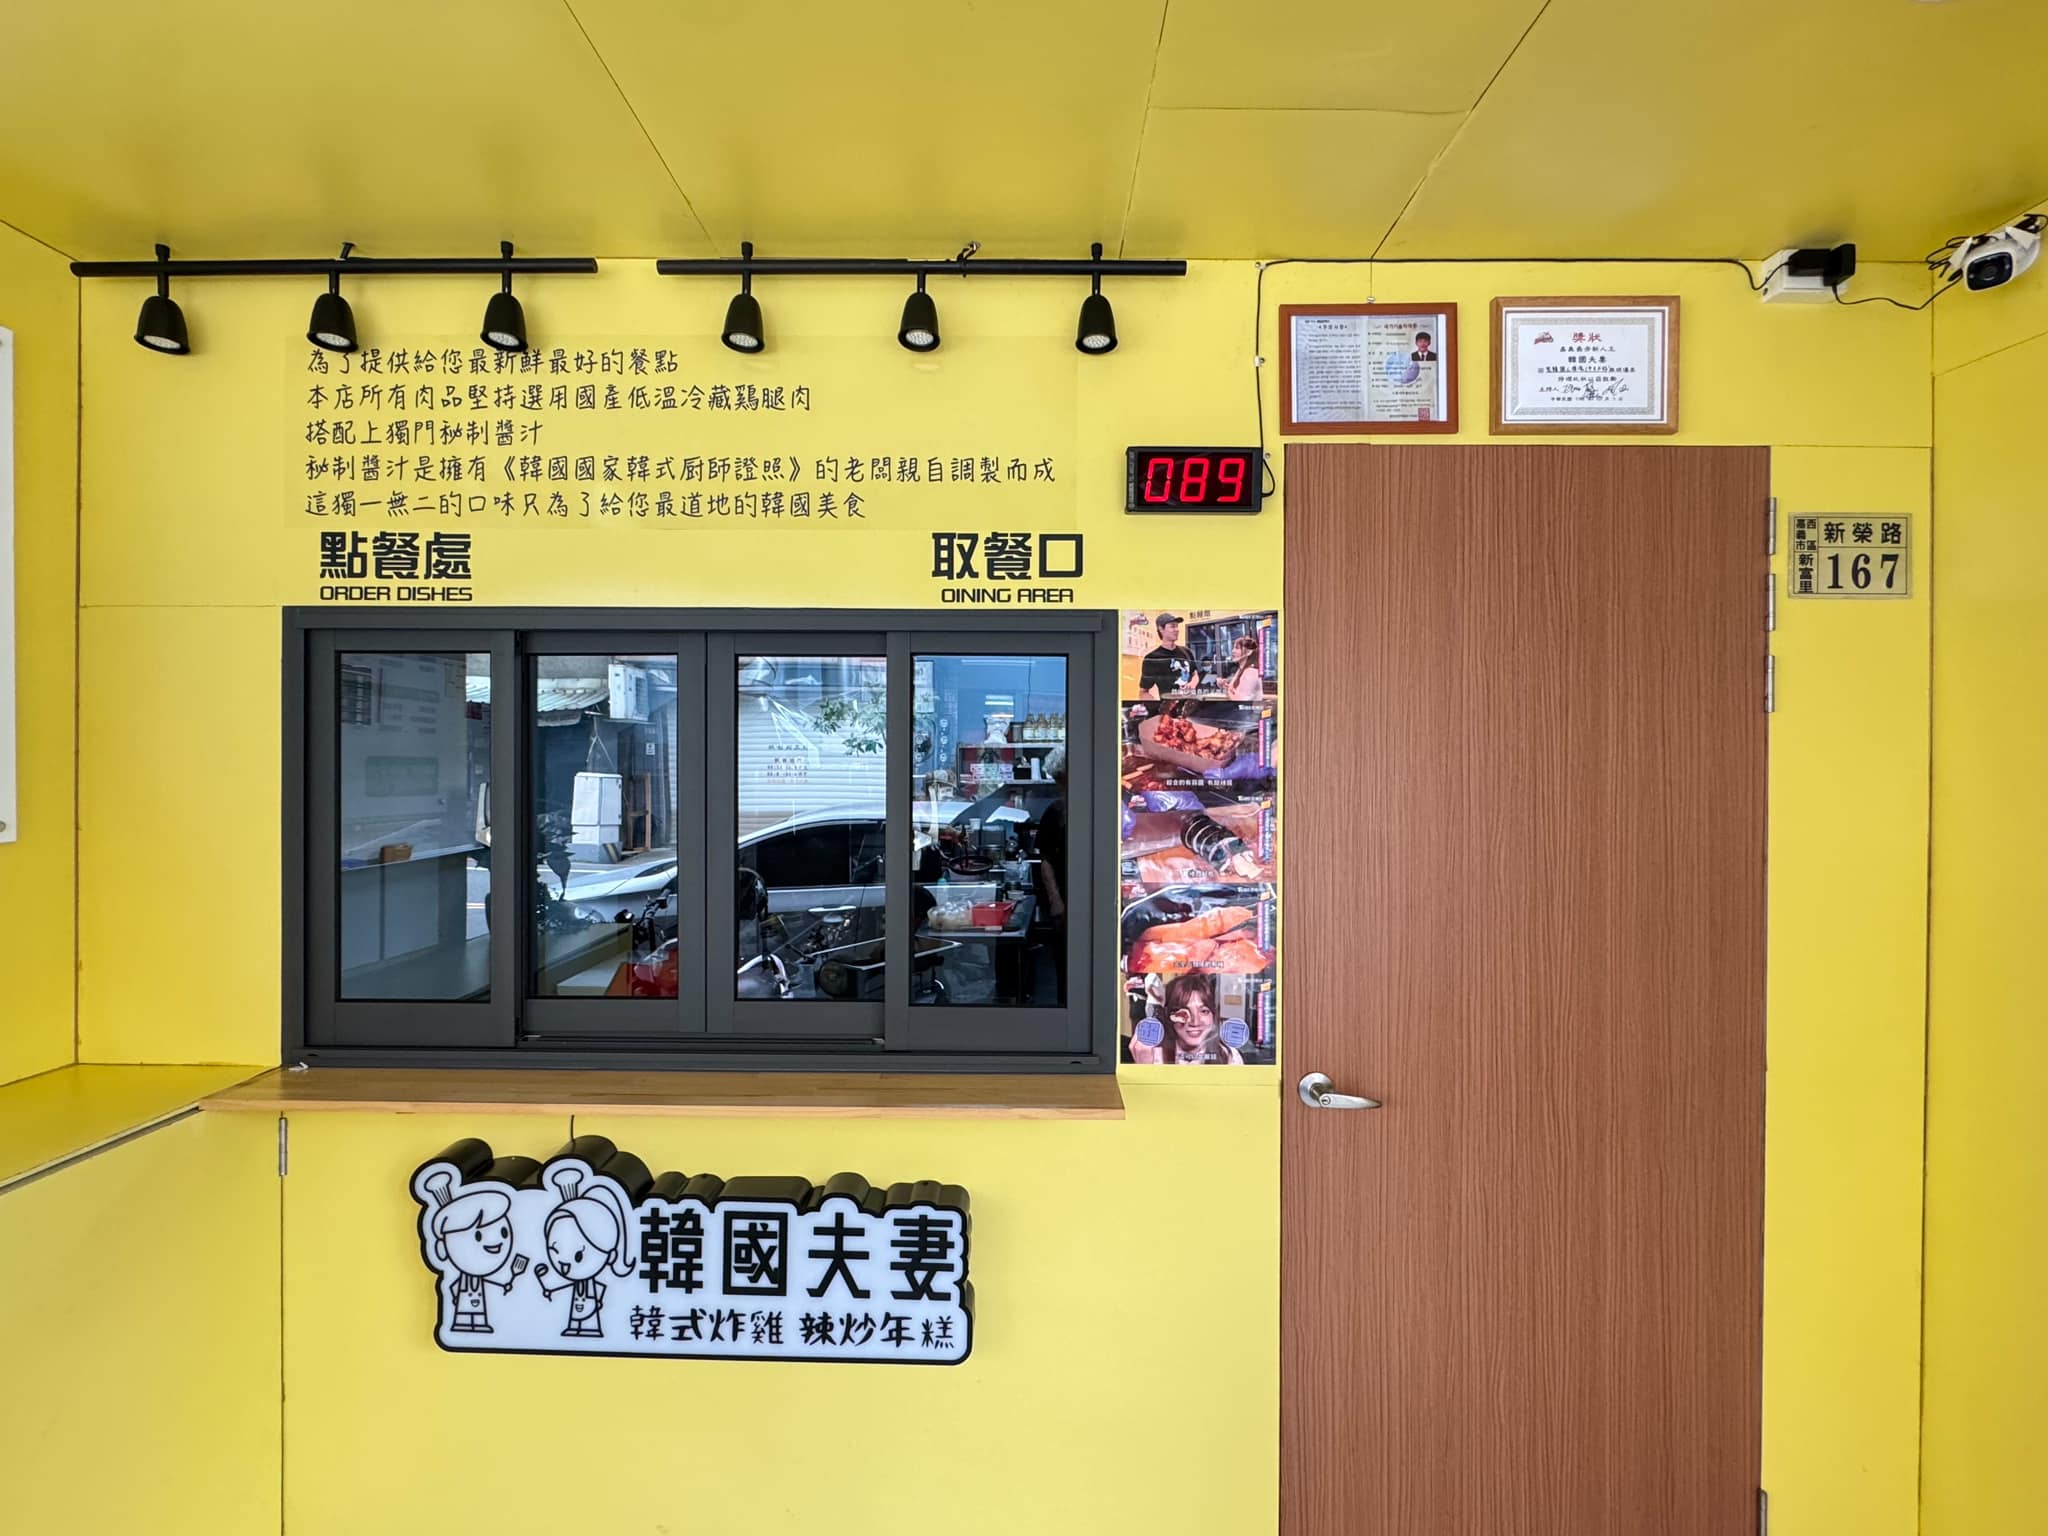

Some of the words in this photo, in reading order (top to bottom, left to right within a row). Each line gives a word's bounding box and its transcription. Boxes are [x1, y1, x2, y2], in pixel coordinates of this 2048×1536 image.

[307, 348, 678, 376] 為了提供給您最新鮮最好的餐點
[1144, 458, 1245, 502] 089
[305, 491, 866, 519] 這獨一無二的口味只為了給您最道地的韓國美食
[1824, 521, 1902, 545] 新榮路
[320, 531, 472, 580] 點餐處
[932, 532, 1083, 580] 取餐口
[1827, 553, 1900, 589] 167
[320, 586, 391, 601] ORDER
[397, 586, 473, 602] DISHES
[1017, 588, 1074, 603] AREA
[639, 1207, 956, 1301] 韓國夫妻
[630, 1305, 785, 1346] 韓式炸雞
[799, 1311, 955, 1349] 辣炒年糕
